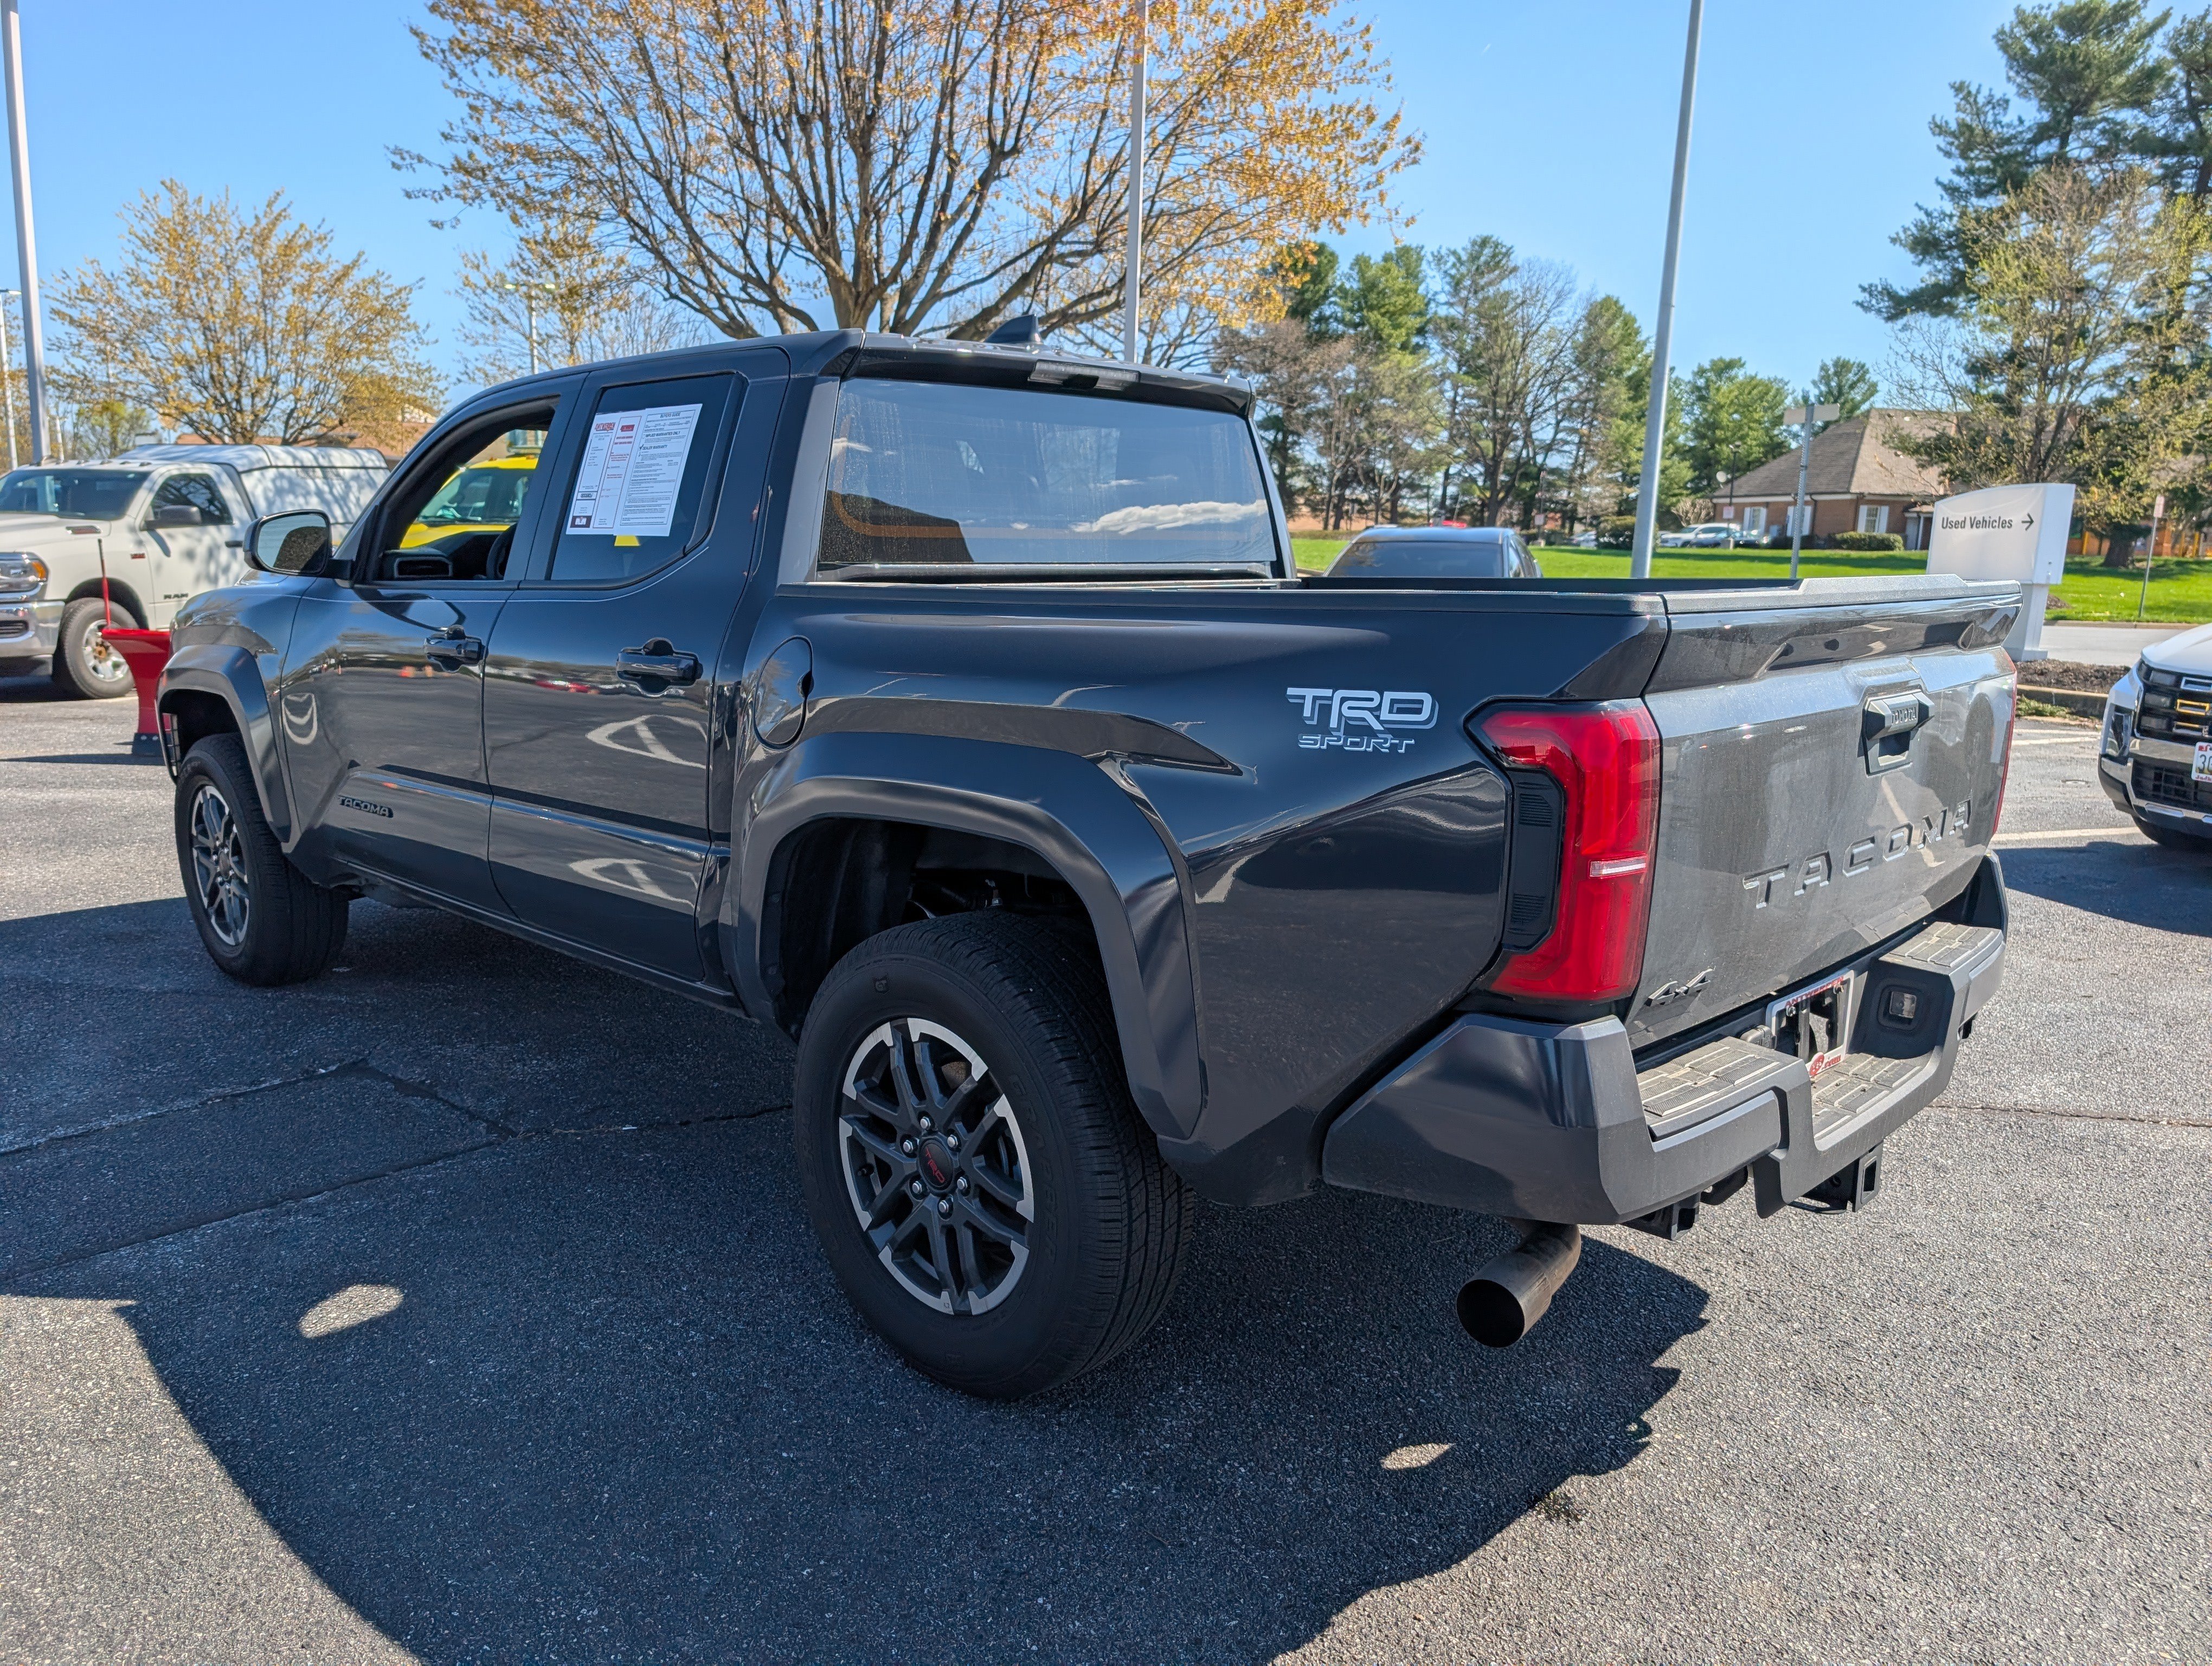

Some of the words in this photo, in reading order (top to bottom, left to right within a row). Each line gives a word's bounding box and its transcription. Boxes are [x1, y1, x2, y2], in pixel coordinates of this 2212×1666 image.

[1941, 516, 1967, 529] Used
[1969, 516, 2013, 529] Vehicles
[1286, 687, 1433, 731] TRD
[1891, 706, 1917, 725] TOYOTA
[1298, 734, 1415, 753] SPORT
[338, 795, 390, 817] TACOMA
[1742, 799, 1972, 909] TACOMA
[925, 1147, 946, 1183] TRD
